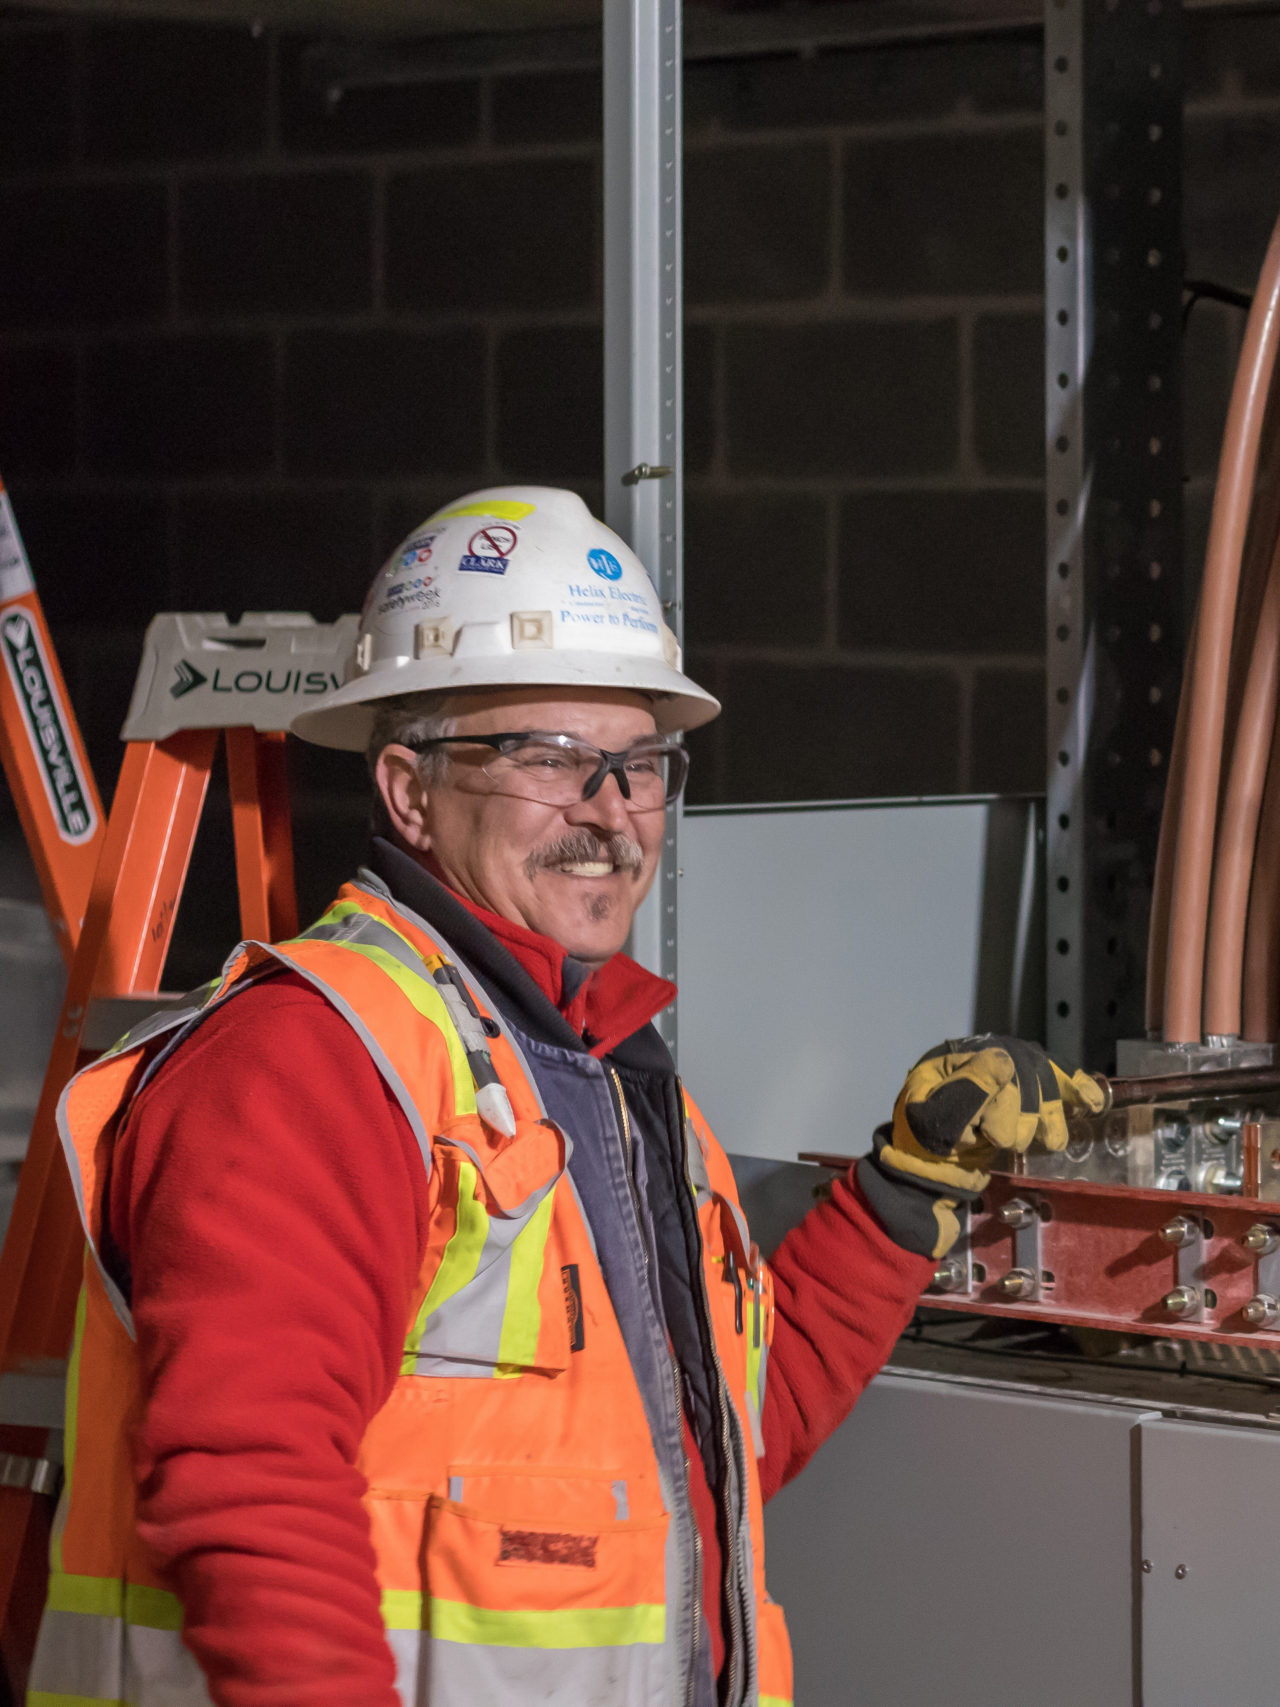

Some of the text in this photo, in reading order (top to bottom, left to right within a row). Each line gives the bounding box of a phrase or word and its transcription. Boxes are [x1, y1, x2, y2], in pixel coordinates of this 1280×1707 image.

[461, 556, 508, 570] CLARK
[569, 584, 607, 599] Helix
[560, 610, 605, 625] Power
[608, 613, 621, 625] to
[15, 646, 87, 834] LOUISVILLE
